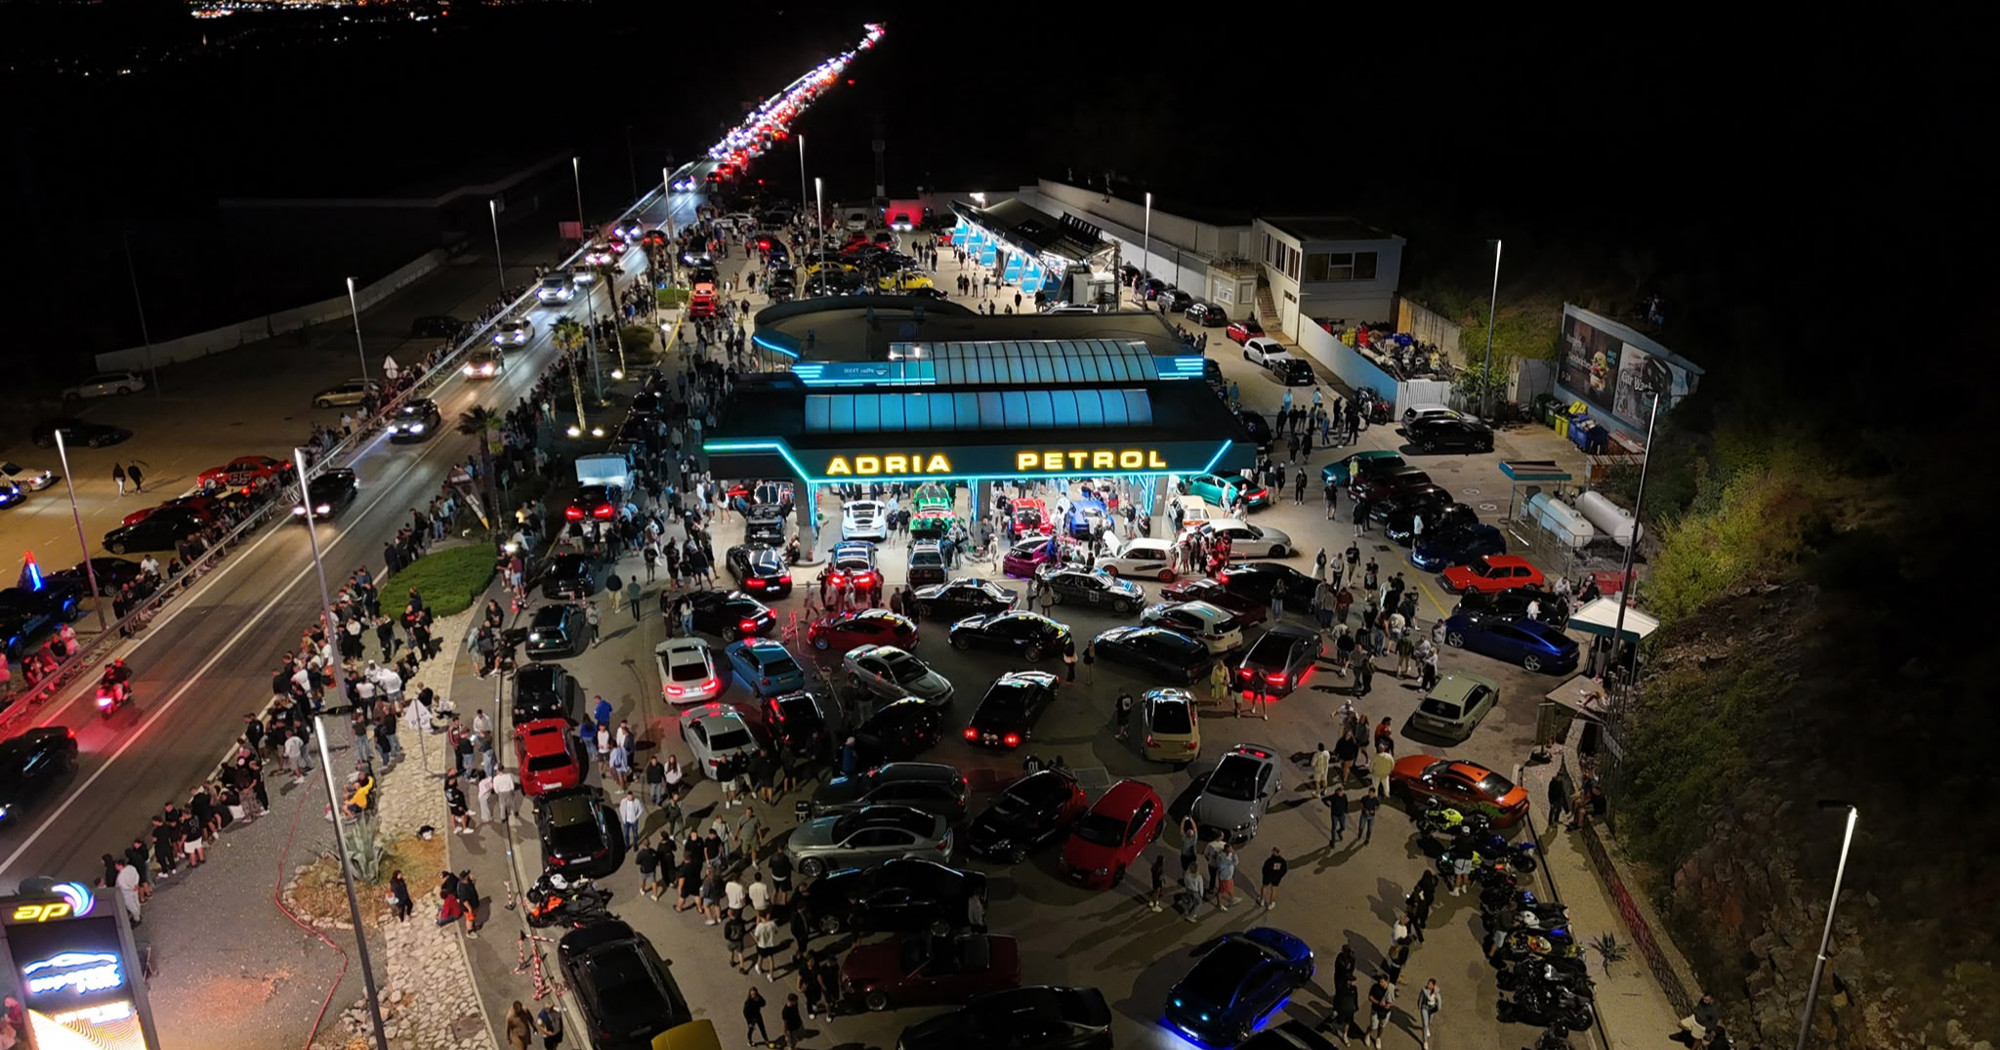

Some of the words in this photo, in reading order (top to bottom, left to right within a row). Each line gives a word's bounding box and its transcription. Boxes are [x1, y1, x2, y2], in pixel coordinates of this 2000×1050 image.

[826, 455, 951, 475] ADRIA
[1017, 451, 1167, 470] PETROL
[13, 903, 71, 922] ap
